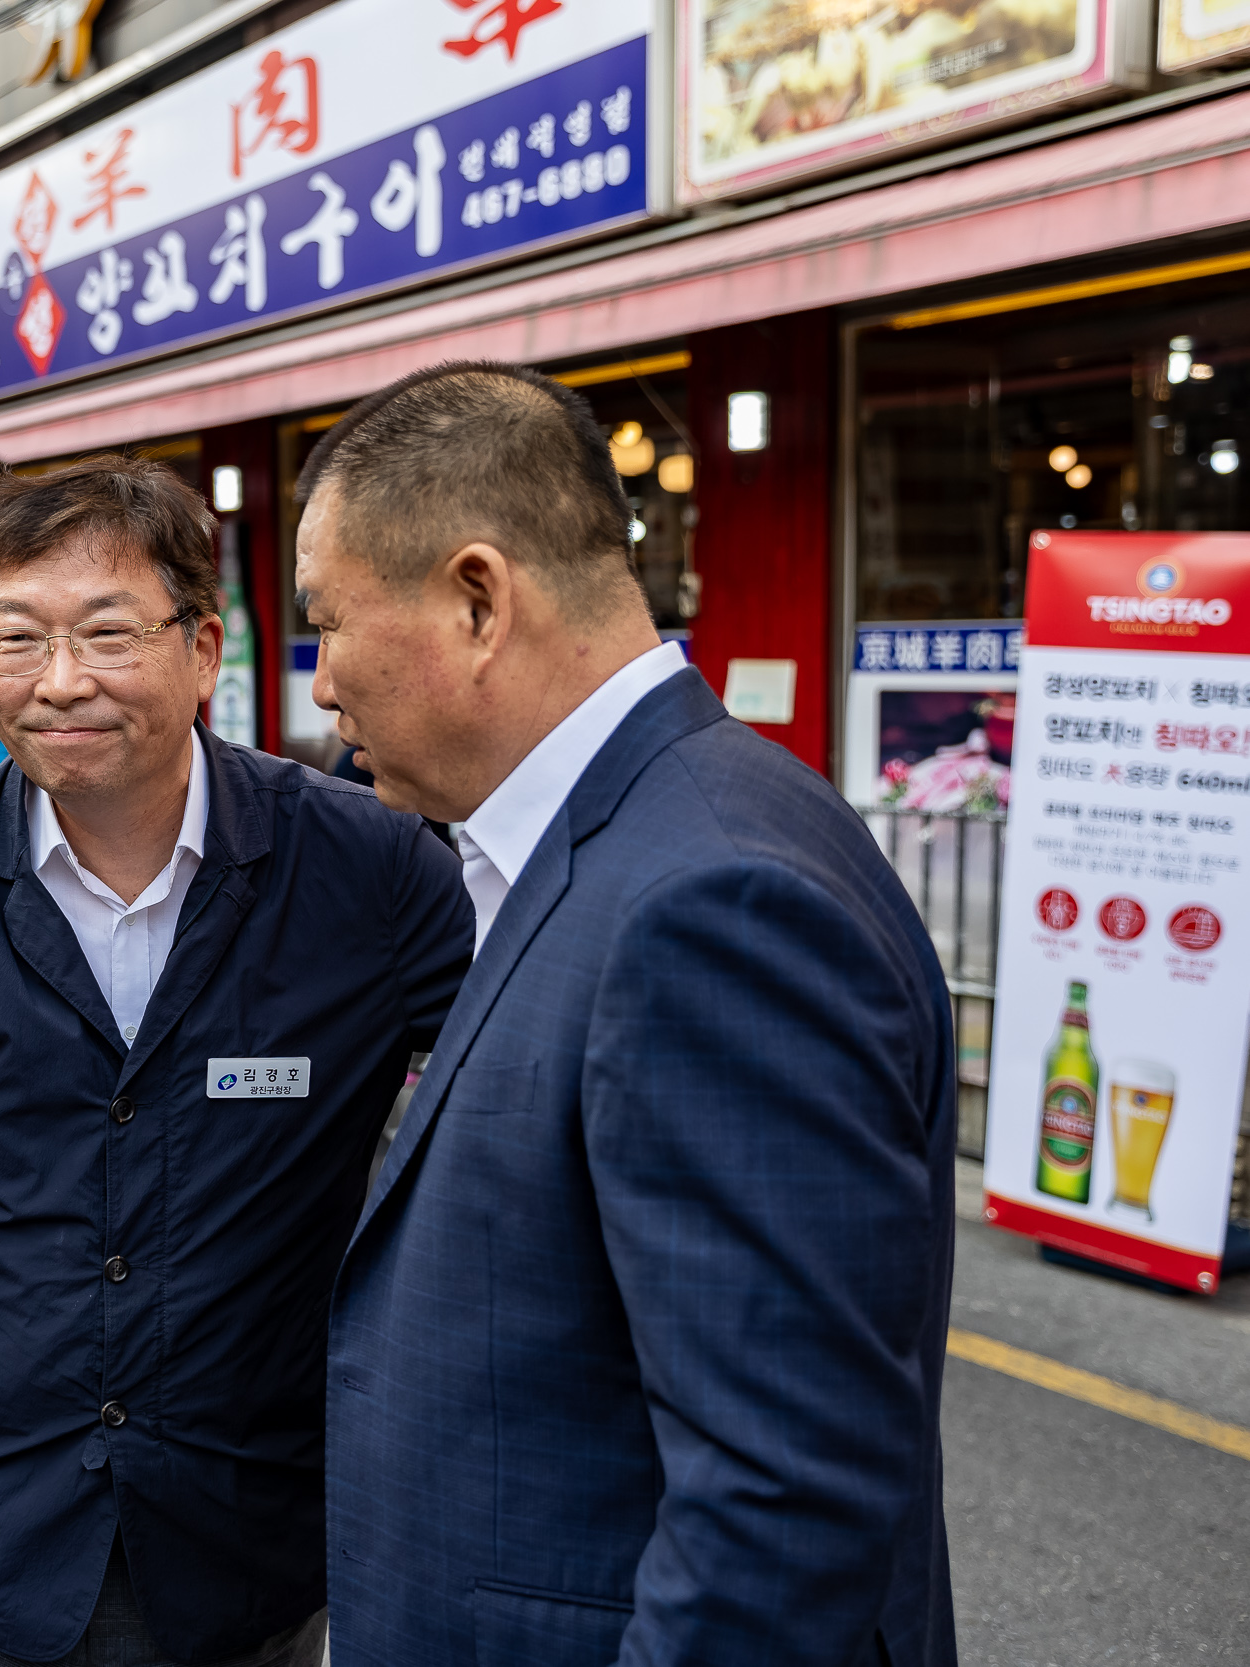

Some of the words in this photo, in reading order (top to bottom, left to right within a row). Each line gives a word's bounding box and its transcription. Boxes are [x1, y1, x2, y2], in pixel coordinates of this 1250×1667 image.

[461, 144, 631, 228] 467-6880
[77, 123, 446, 355] 양꼬치구이
[1086, 595, 1233, 626] TSINGTAO
[250, 1086, 292, 1095] 광진구청장
